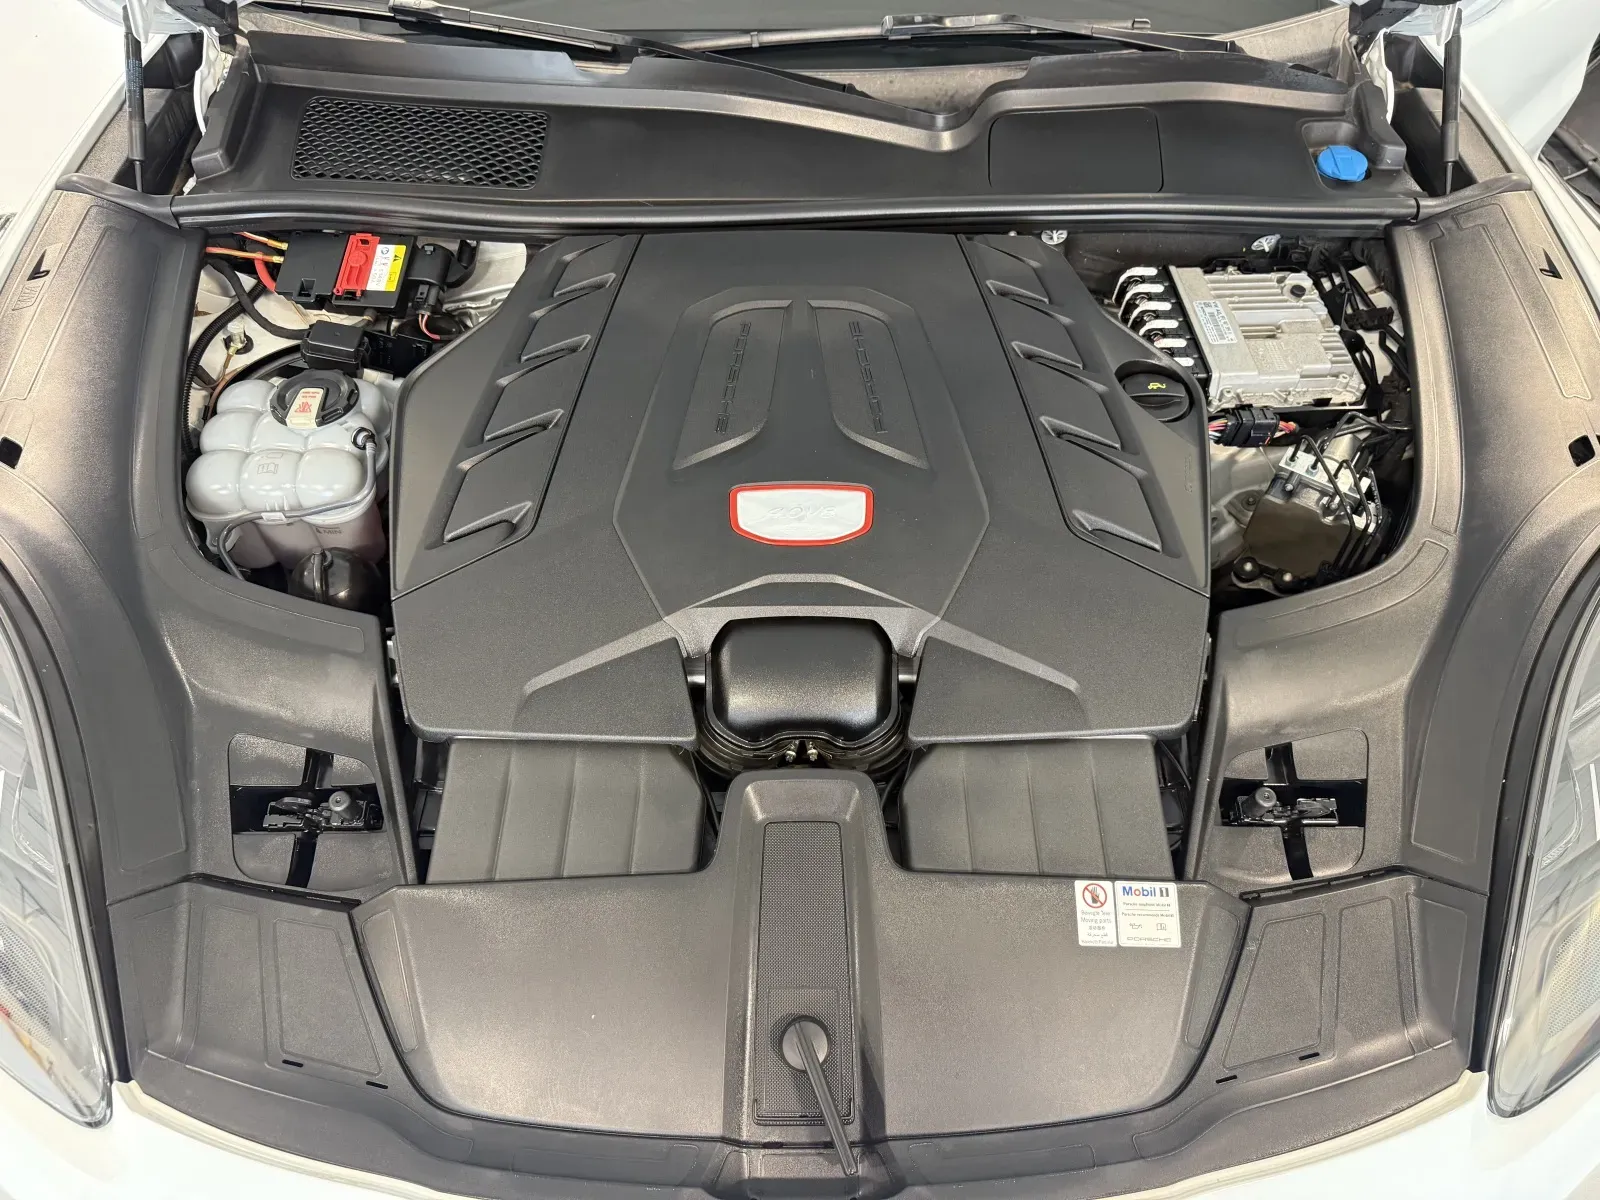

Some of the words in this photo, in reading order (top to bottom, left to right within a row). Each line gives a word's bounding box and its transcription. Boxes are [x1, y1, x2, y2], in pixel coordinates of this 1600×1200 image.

[715, 320, 751, 434] PORSCHE
[849, 320, 888, 434] PORSCHE
[1122, 886, 1156, 897] Mobil
[1159, 887, 1169, 897] 1
